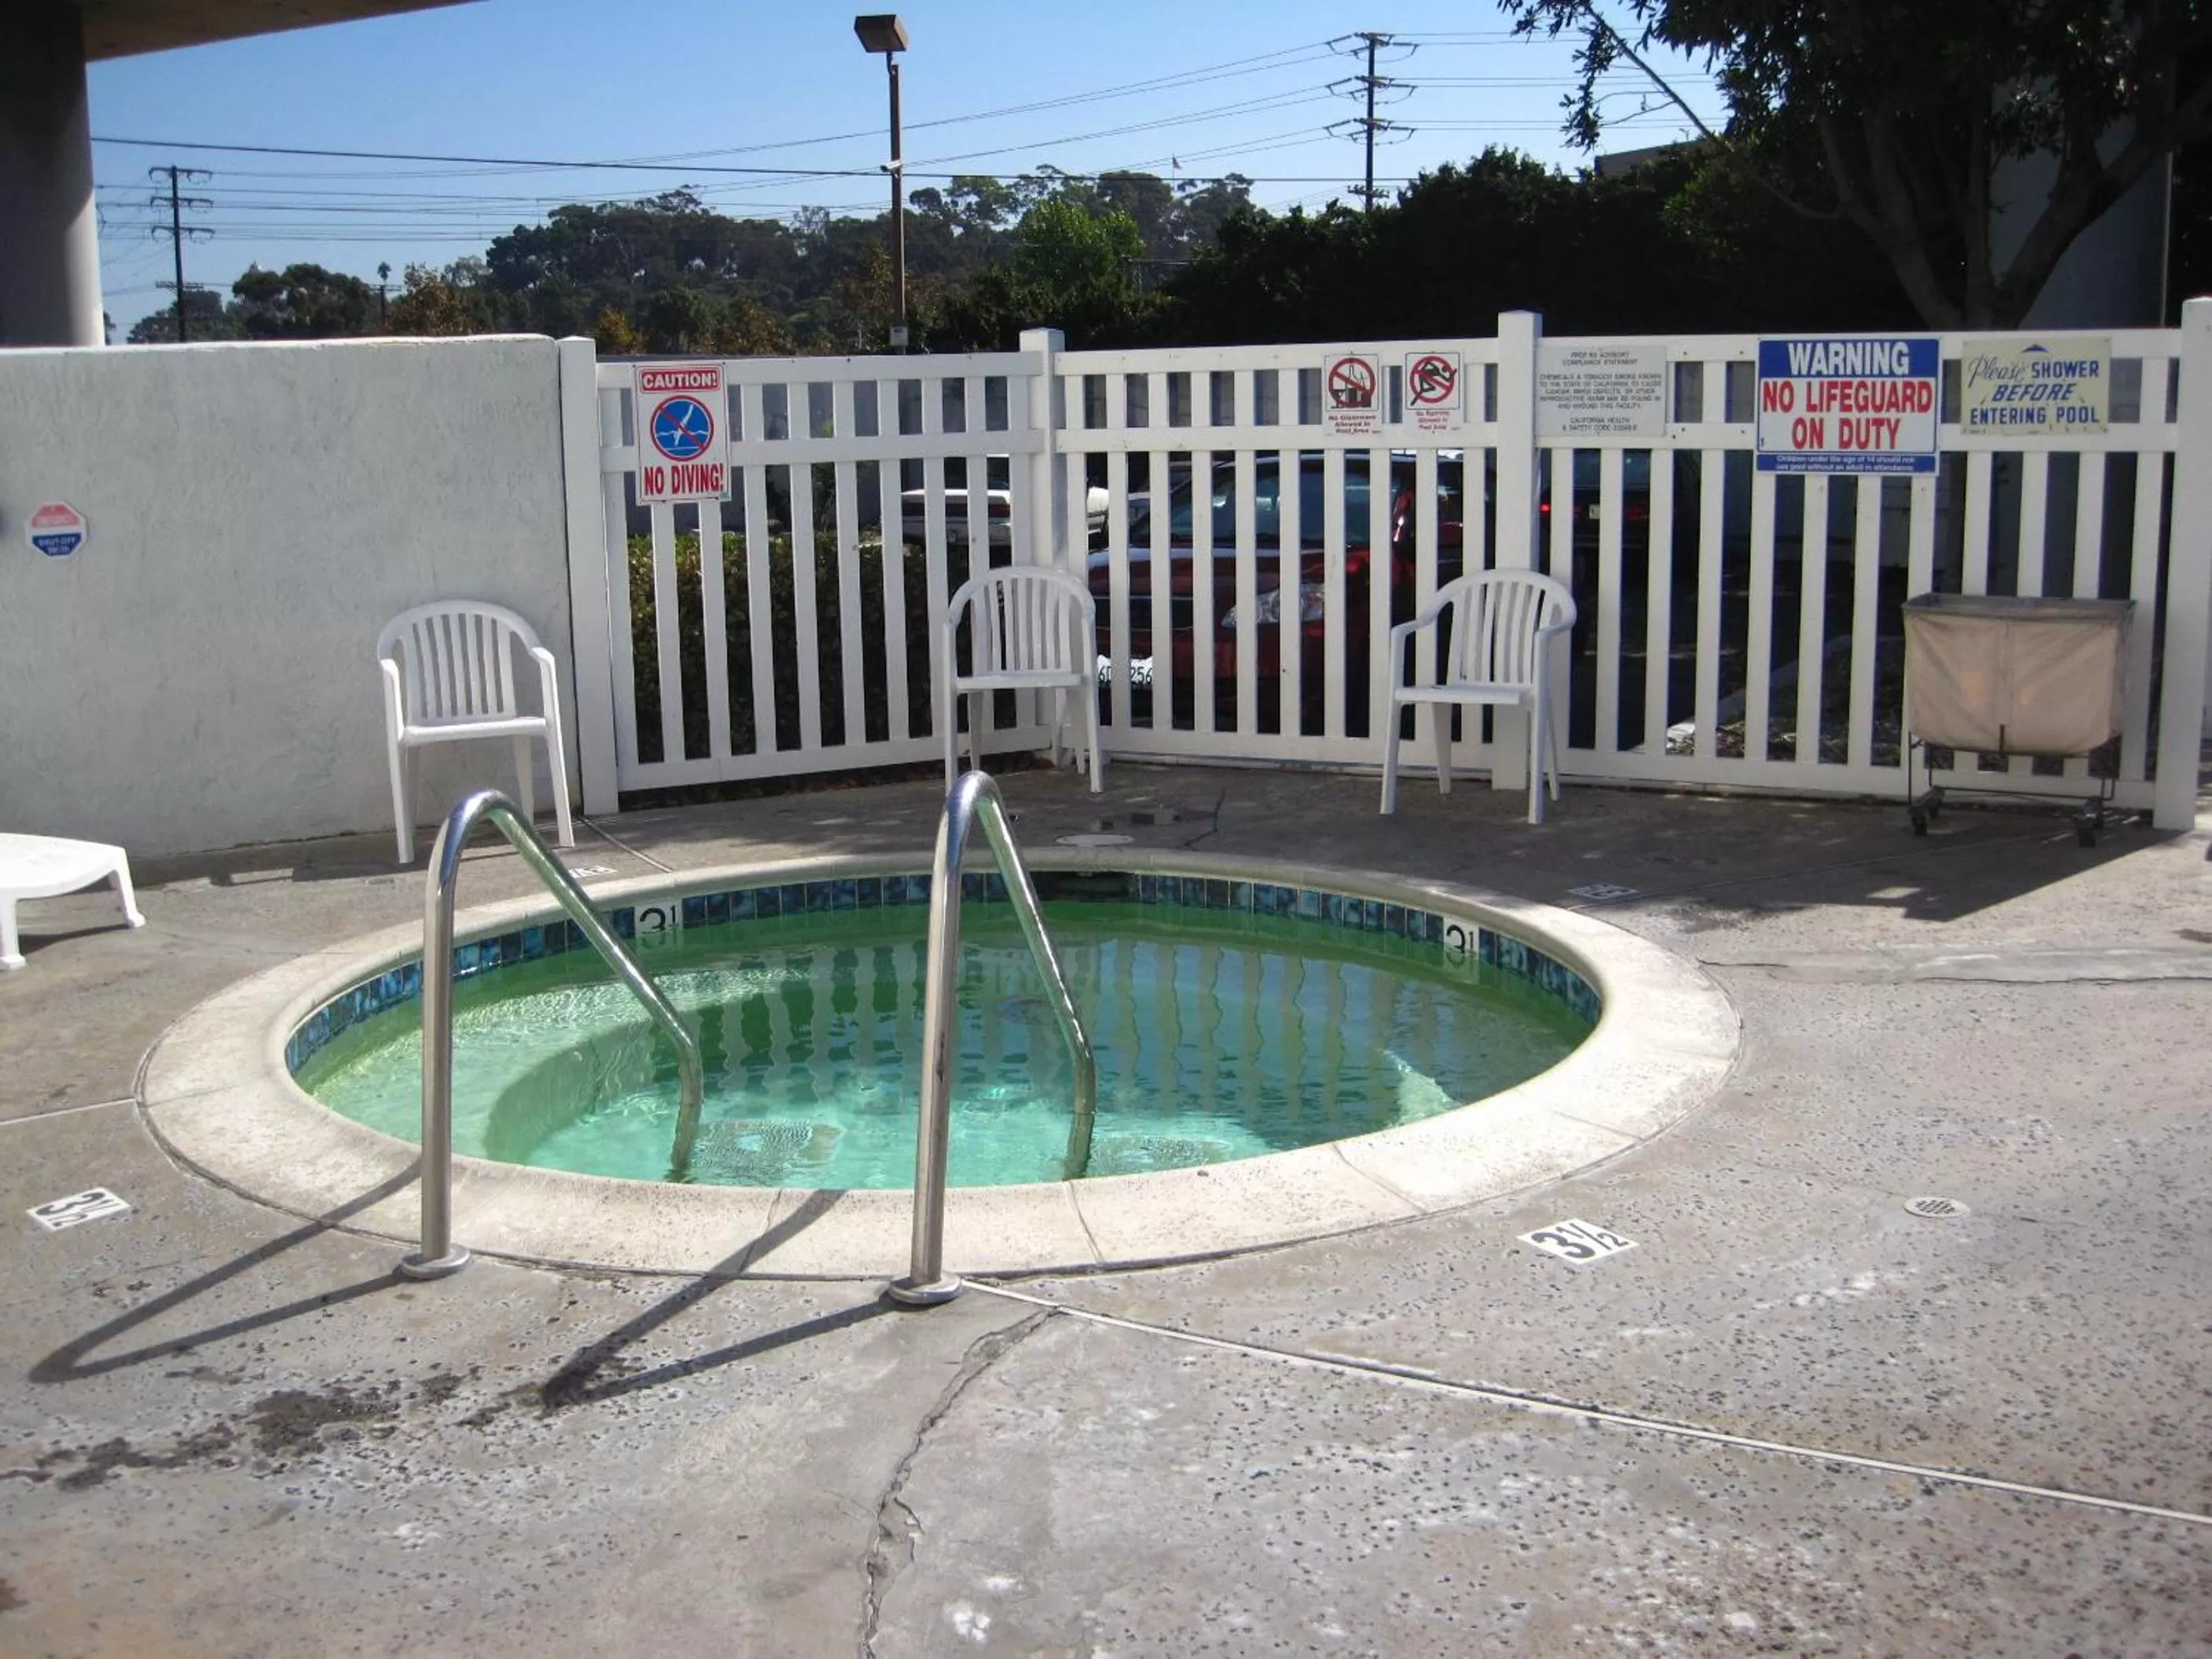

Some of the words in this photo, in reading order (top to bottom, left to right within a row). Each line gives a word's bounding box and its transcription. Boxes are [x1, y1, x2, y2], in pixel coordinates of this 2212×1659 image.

[1788, 342, 1910, 375] WARNING
[1968, 353, 2026, 389] Please
[2031, 360, 2099, 379] SHOWER
[643, 373, 717, 388] CAUTION!
[1763, 380, 1794, 412] NO
[1806, 380, 1933, 413] LIFEGUARD
[1991, 383, 2077, 402] BEFORE
[1970, 406, 2046, 425] ENTERING
[2056, 406, 2100, 423] POOL
[1792, 416, 1824, 450] ON
[1838, 418, 1900, 450] DUTY
[644, 466, 665, 496] NO
[672, 463, 723, 494] DIVING!
